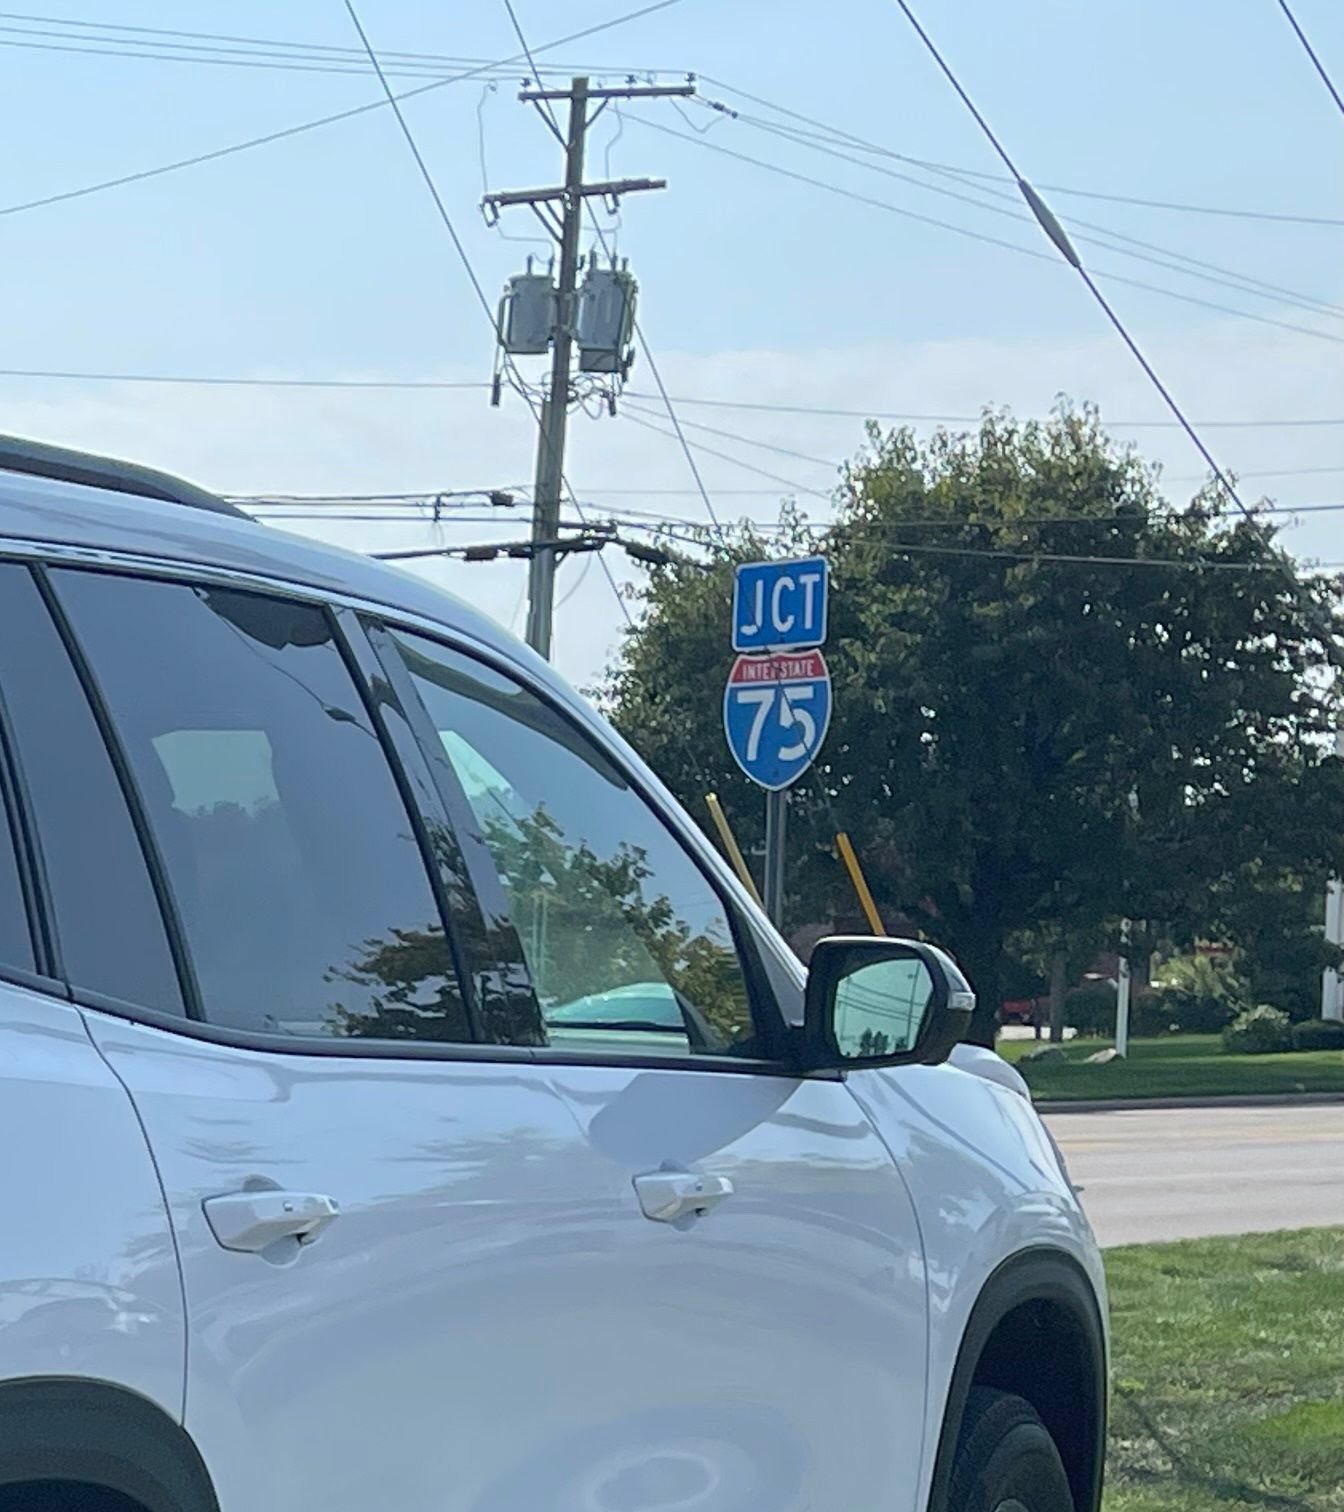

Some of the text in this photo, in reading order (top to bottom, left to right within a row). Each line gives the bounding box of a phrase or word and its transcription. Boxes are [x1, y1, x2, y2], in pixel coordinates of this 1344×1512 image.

[739, 573, 820, 636] JCT
[742, 660, 814, 681] INTERSTATE
[736, 685, 816, 762] 75
